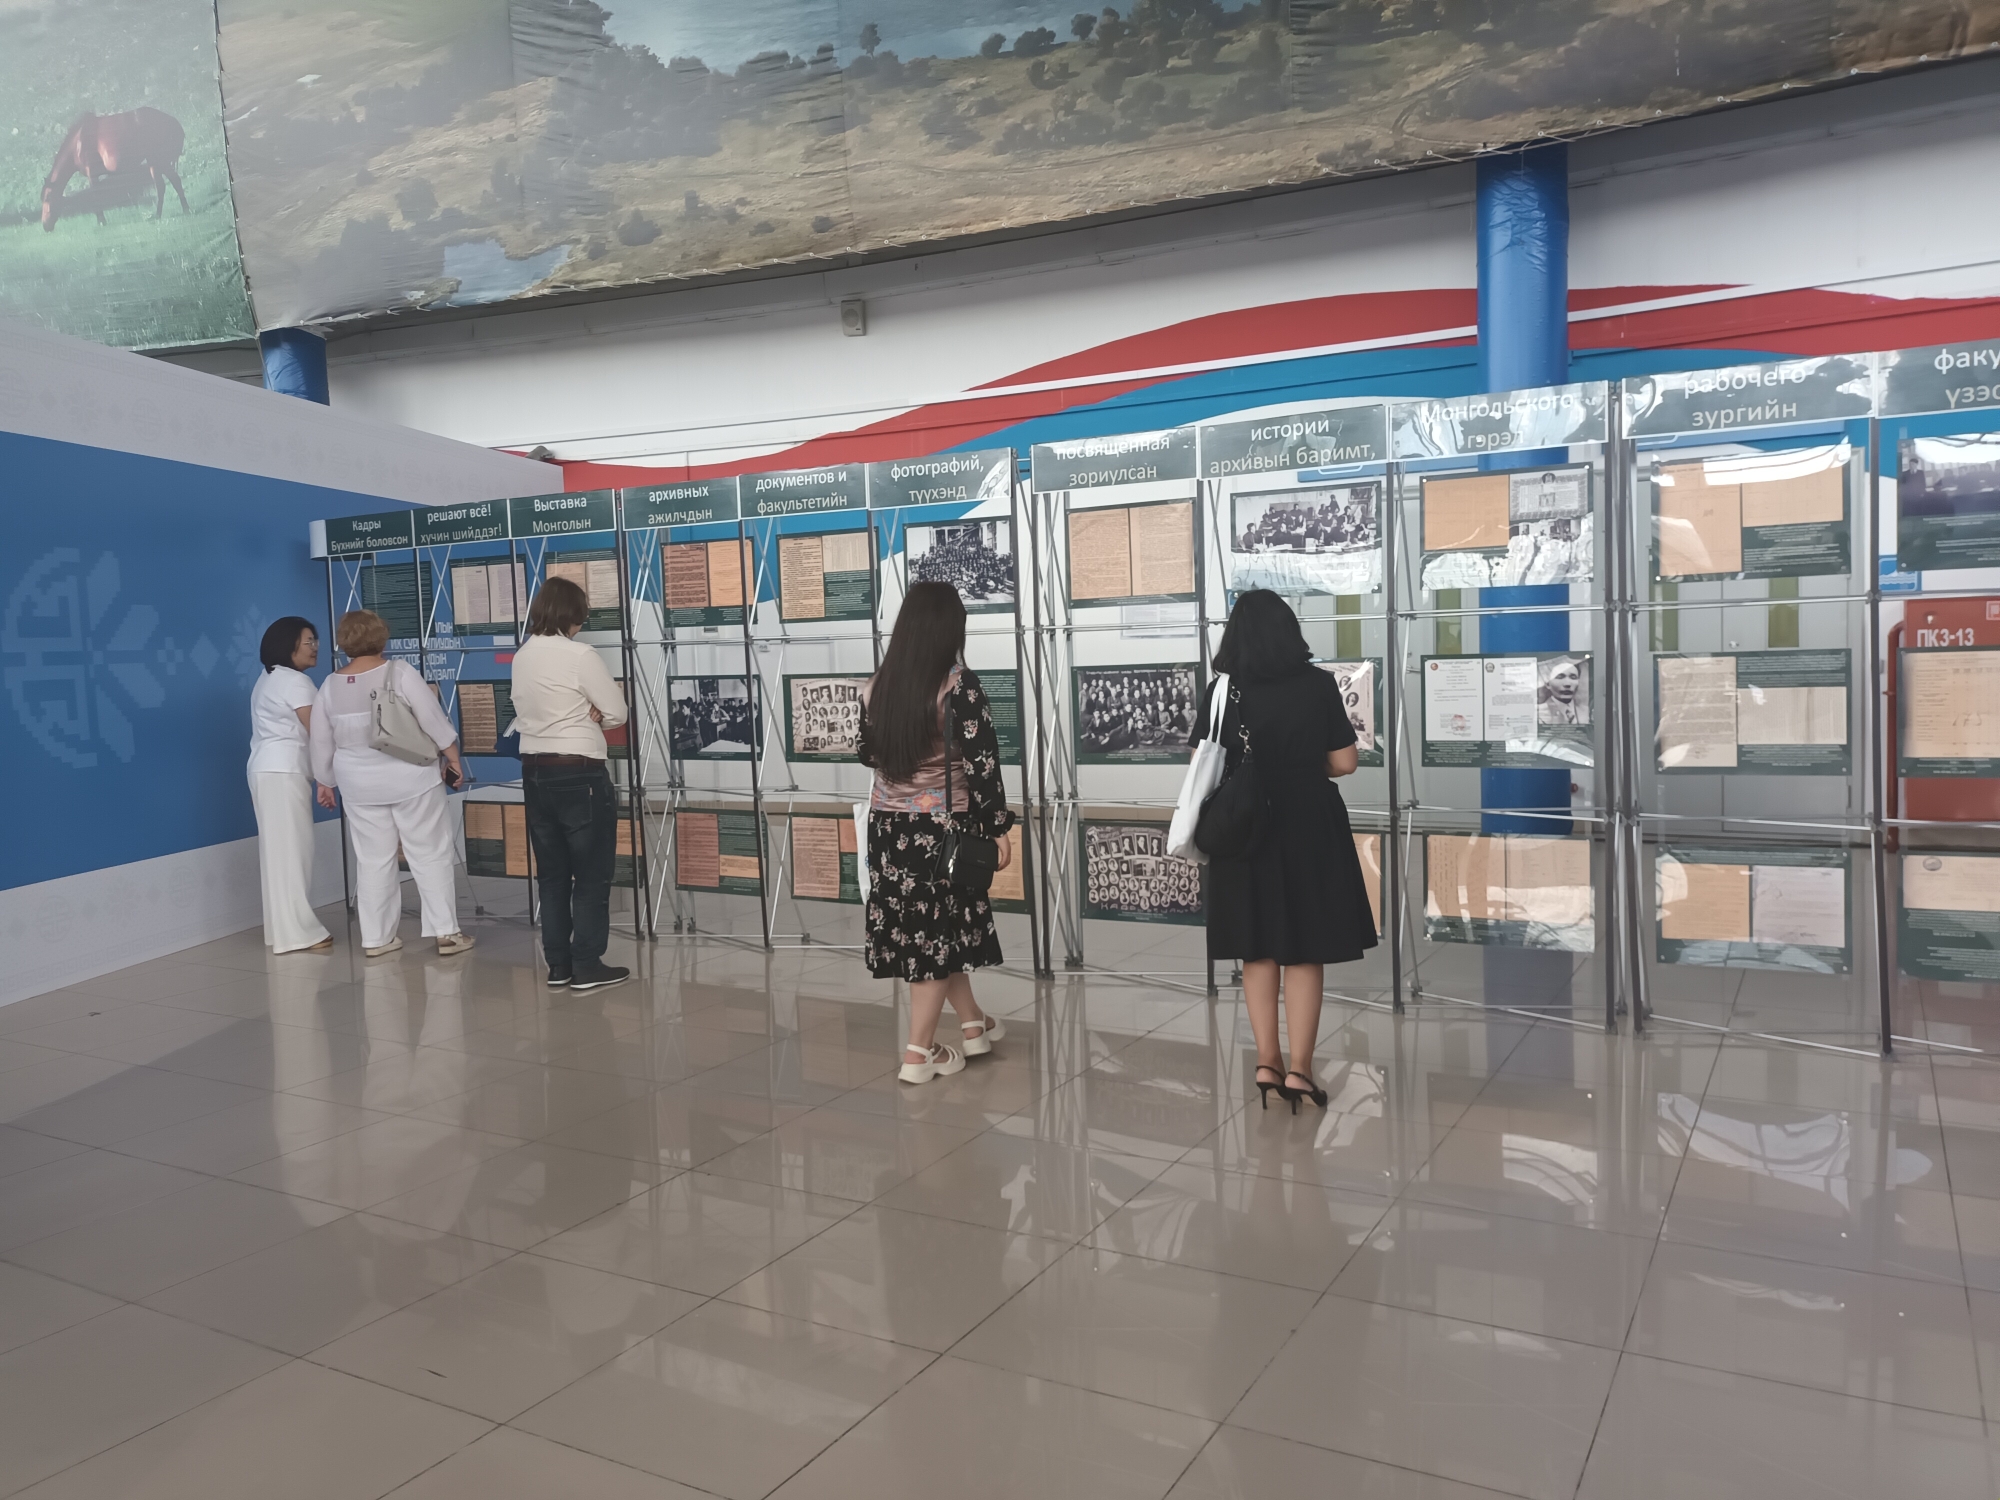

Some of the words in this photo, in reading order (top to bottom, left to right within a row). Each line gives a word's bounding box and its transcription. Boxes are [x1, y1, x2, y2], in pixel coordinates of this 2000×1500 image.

[1933, 348, 2000, 375] факу
[1684, 366, 1807, 399] рабочего
[1421, 393, 1574, 424] Монгольского
[1692, 399, 1797, 430] зургийн
[1251, 418, 1329, 442] истории
[1467, 430, 1524, 451] гэрэл
[1056, 436, 1170, 461] посвященная
[1209, 452, 1290, 476] архивын
[1296, 442, 1376, 467] баримт,
[890, 454, 984, 482] фотографий,
[1068, 463, 1157, 487] зориулсан
[756, 471, 835, 493] документов
[838, 470, 847, 482] и
[534, 496, 587, 512] Выставка
[649, 485, 709, 505] архивных
[757, 492, 847, 516] факультетийн
[908, 485, 967, 505] түүхэнд
[352, 519, 382, 533] Кадры
[427, 508, 467, 526] решают
[469, 503, 492, 519] всё!
[533, 518, 592, 533] Монголын
[648, 508, 713, 525] ажилчдын
[331, 537, 365, 553] Бүхнийг
[366, 534, 409, 548] боловсон
[420, 531, 450, 546] хүчин
[452, 523, 502, 541] шийддэг!
